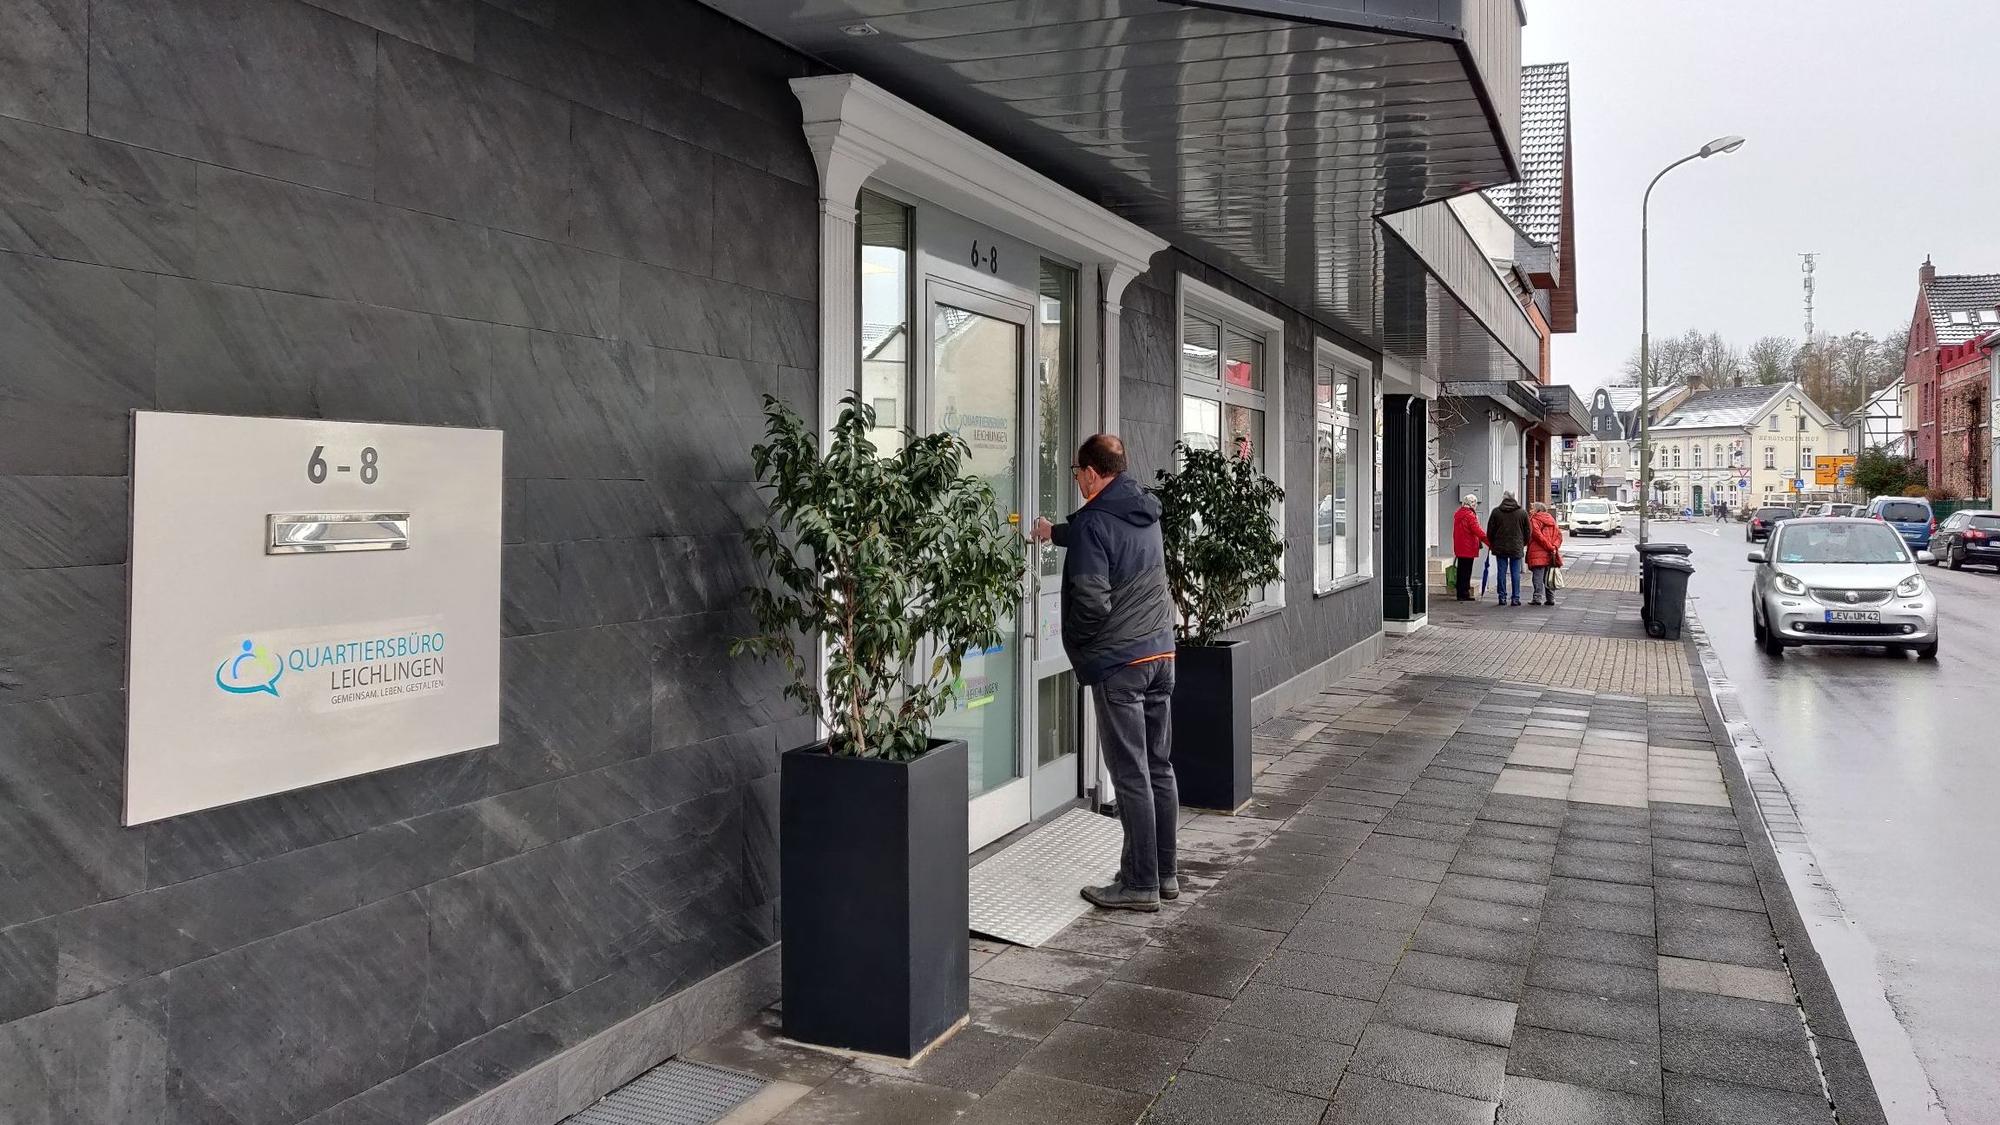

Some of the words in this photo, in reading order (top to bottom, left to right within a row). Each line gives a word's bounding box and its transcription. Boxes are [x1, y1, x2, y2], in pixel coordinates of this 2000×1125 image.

[288, 632, 444, 671] QUARTIERSBÜRO
[331, 656, 444, 690] LEICHLINGEN
[331, 690, 380, 704] GEMEINSAM.
[380, 686, 405, 698] LEBEN.
[405, 680, 444, 692] GESTALTEN
